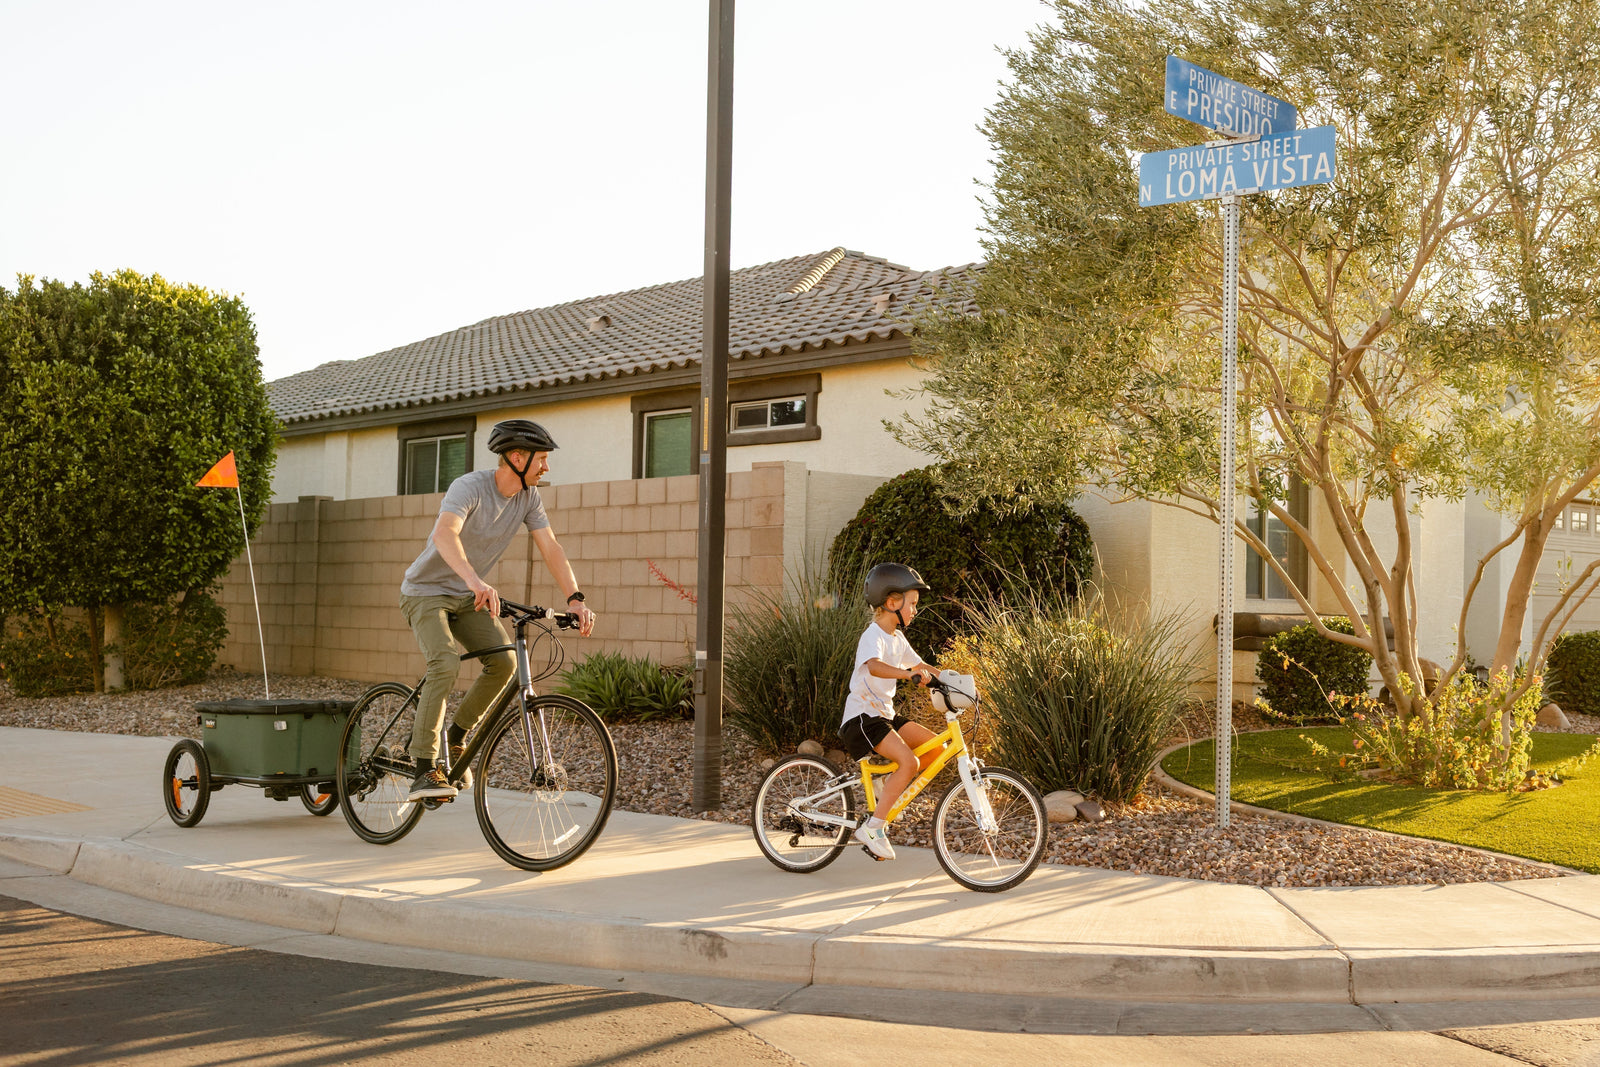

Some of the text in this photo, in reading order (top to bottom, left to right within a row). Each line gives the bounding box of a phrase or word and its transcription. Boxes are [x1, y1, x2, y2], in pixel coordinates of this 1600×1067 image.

[1171, 88, 1272, 135] E PRESIDIO
[1189, 68, 1279, 120] PRIVATE STREET
[1141, 152, 1332, 202] N LOMA VISTA
[1168, 135, 1302, 172] PRIVATE STREET
